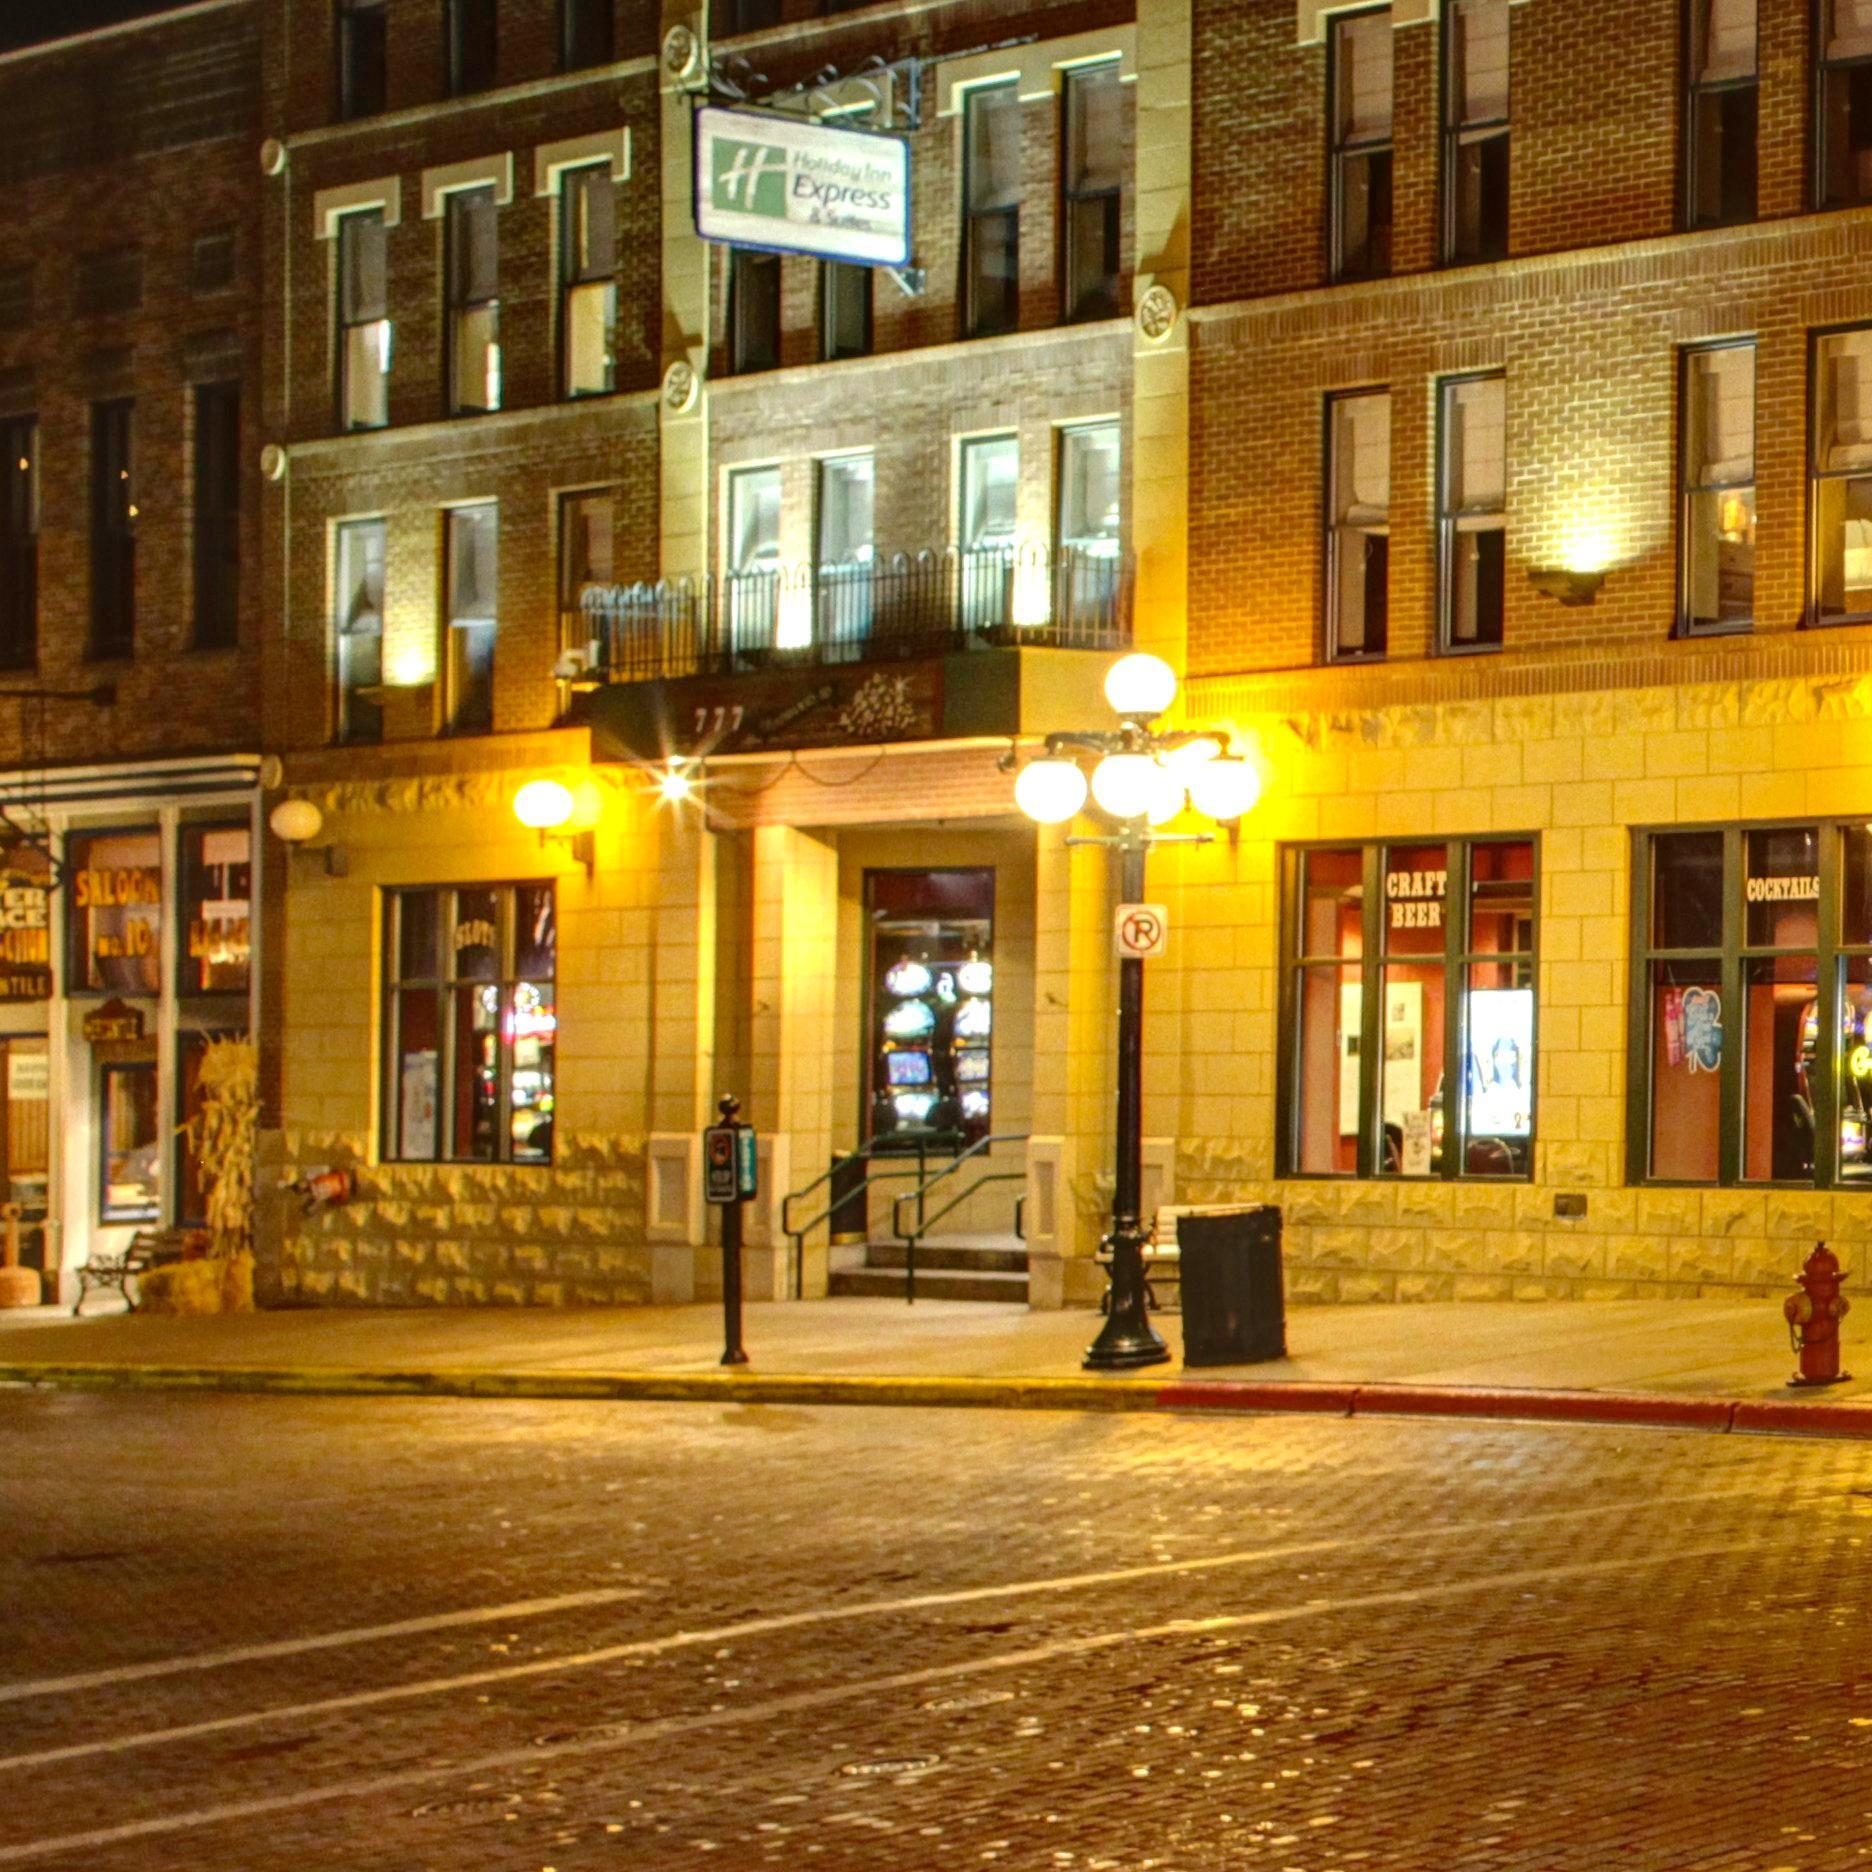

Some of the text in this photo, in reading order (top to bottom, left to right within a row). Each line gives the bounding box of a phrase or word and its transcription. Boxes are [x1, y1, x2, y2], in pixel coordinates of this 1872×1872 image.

[795, 151, 892, 182] Holiday Inn
[793, 172, 891, 210] Express
[810, 207, 871, 229] & Suites
[1386, 870, 1448, 897] CRAFT
[1746, 876, 1820, 902] COCKTAILS
[1391, 901, 1442, 927] BEER
